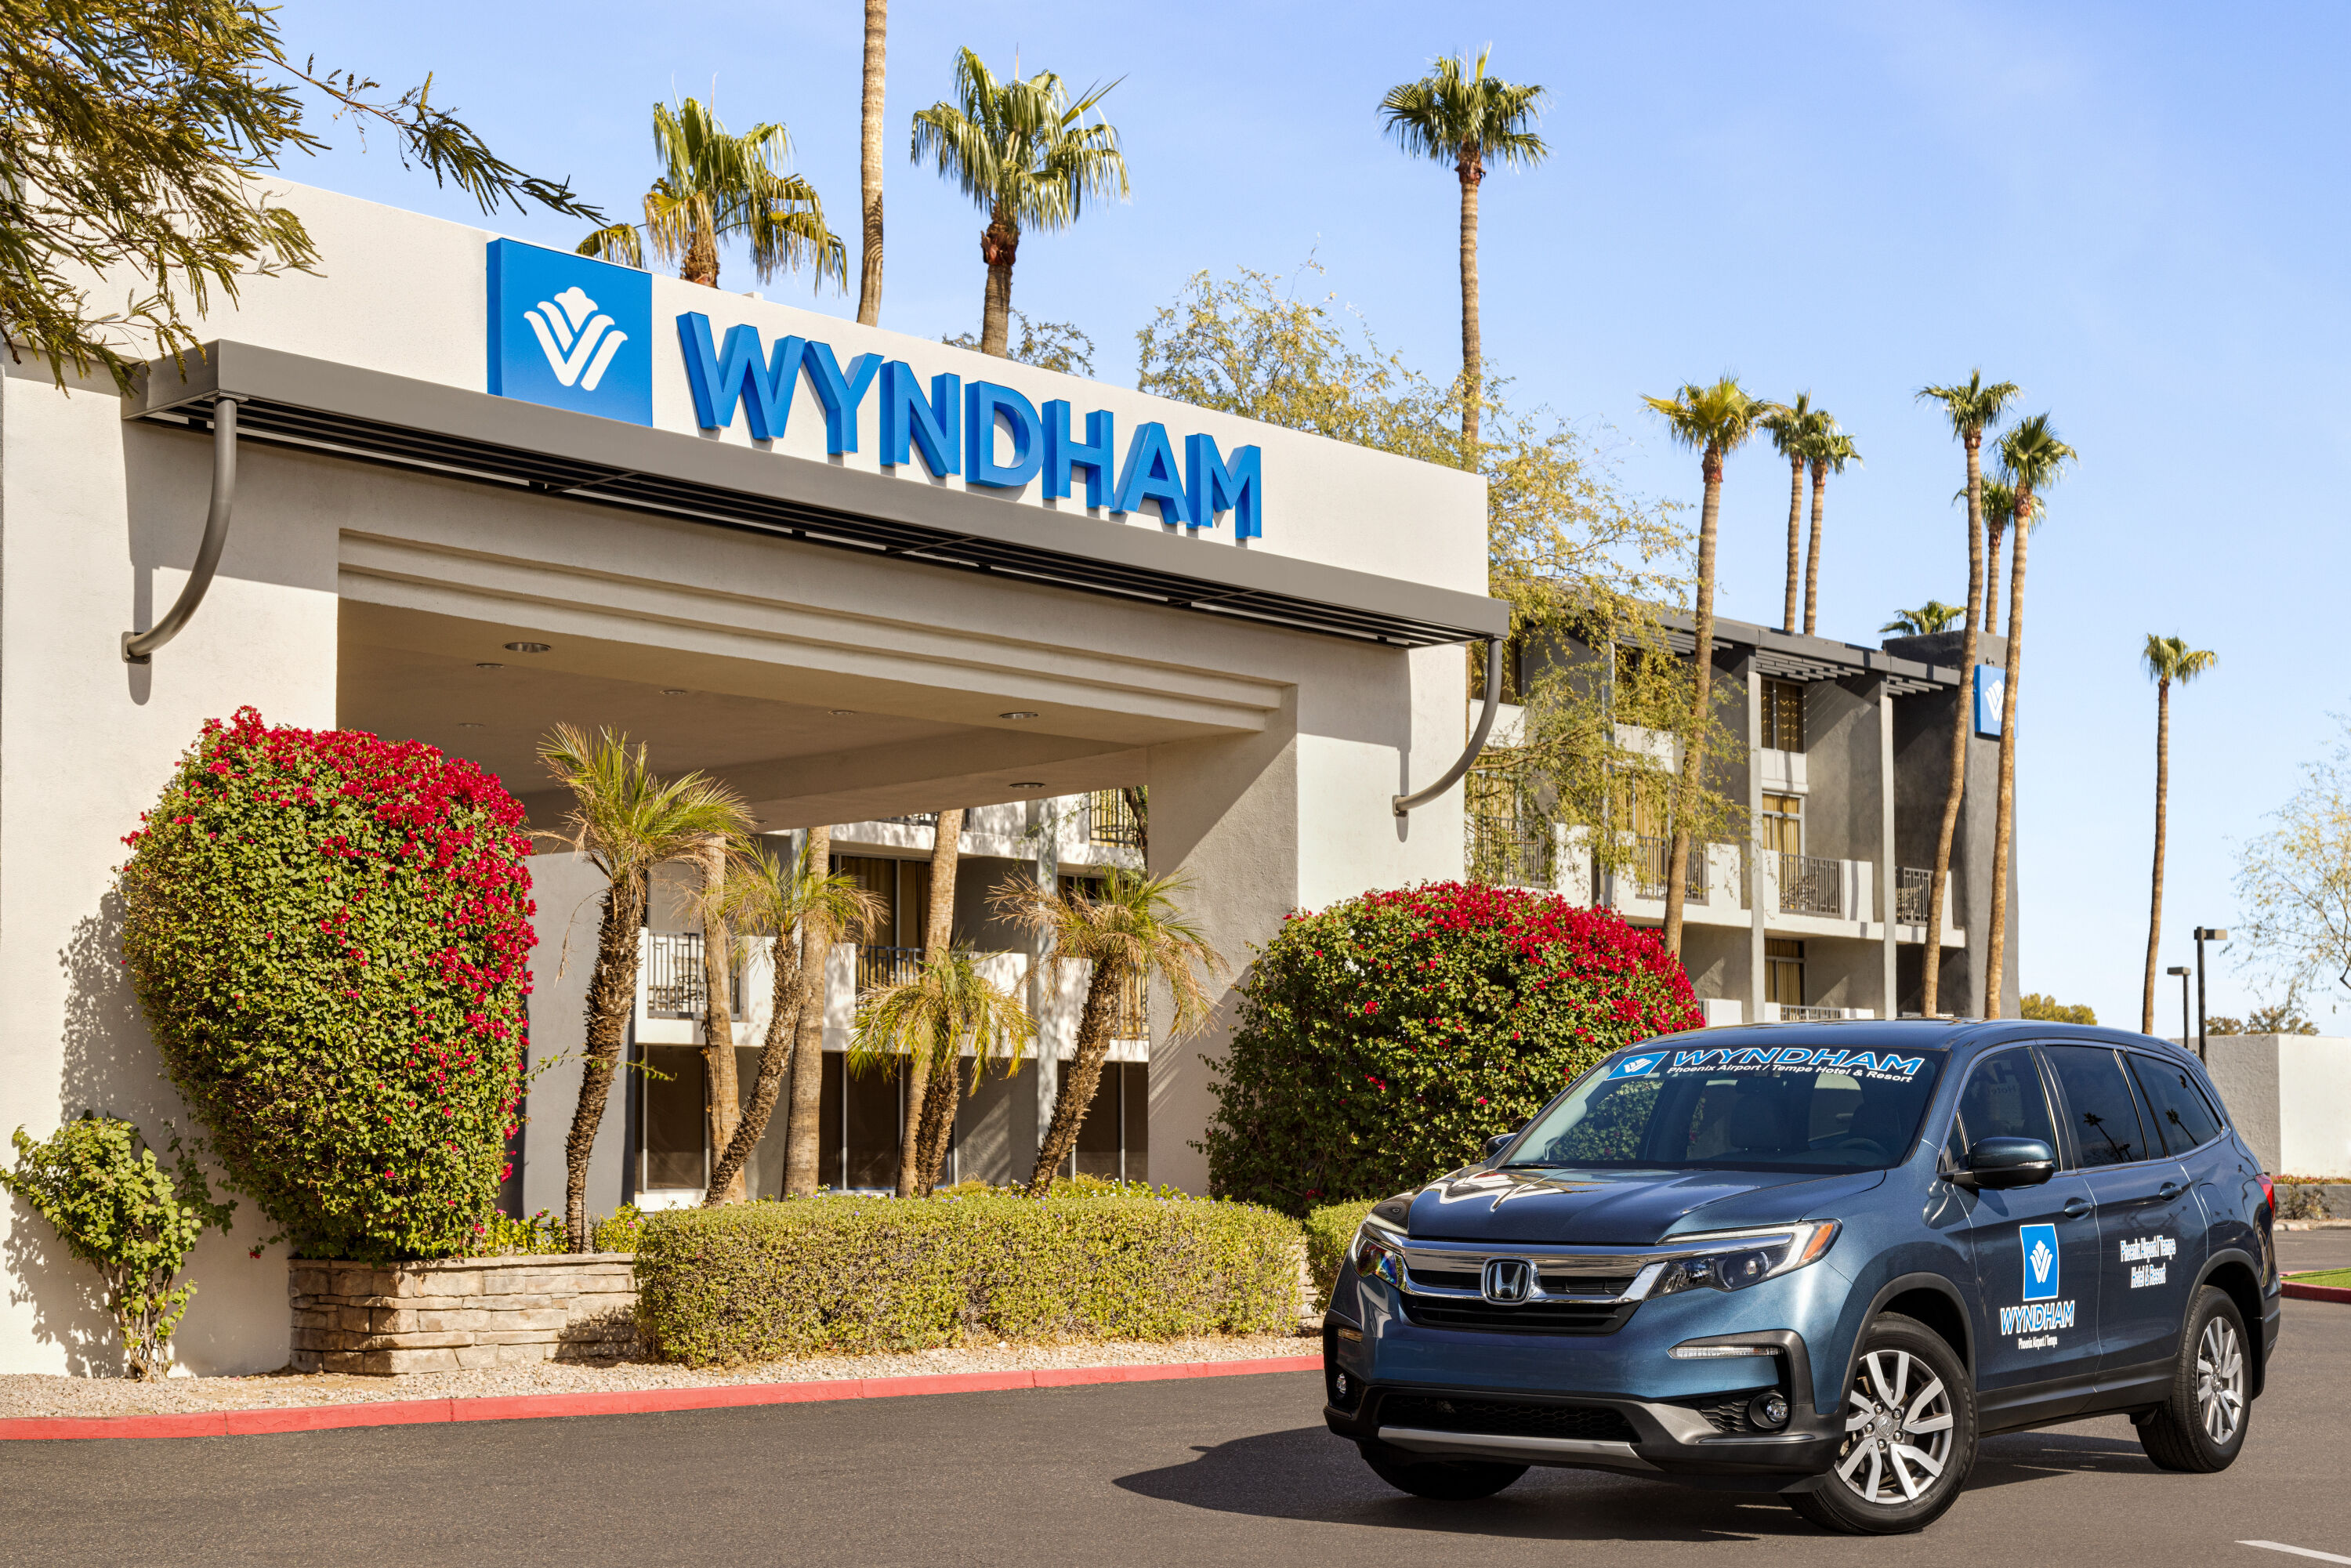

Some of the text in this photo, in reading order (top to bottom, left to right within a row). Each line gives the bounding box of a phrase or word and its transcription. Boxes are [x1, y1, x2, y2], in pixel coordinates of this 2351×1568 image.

[676, 310, 1262, 540] WYNDHAM
[1667, 1064, 1716, 1074] Phoenix
[1772, 1064, 1812, 1073] Tempe
[1815, 1066, 1851, 1075] Hotel
[1866, 1070, 1913, 1083] Resort
[1673, 1047, 1925, 1076] WYNDHAM
[2131, 1265, 2144, 1289] Hotel
[2150, 1262, 2166, 1286] Resort
[2000, 1299, 2075, 1336] WYNDHAM
